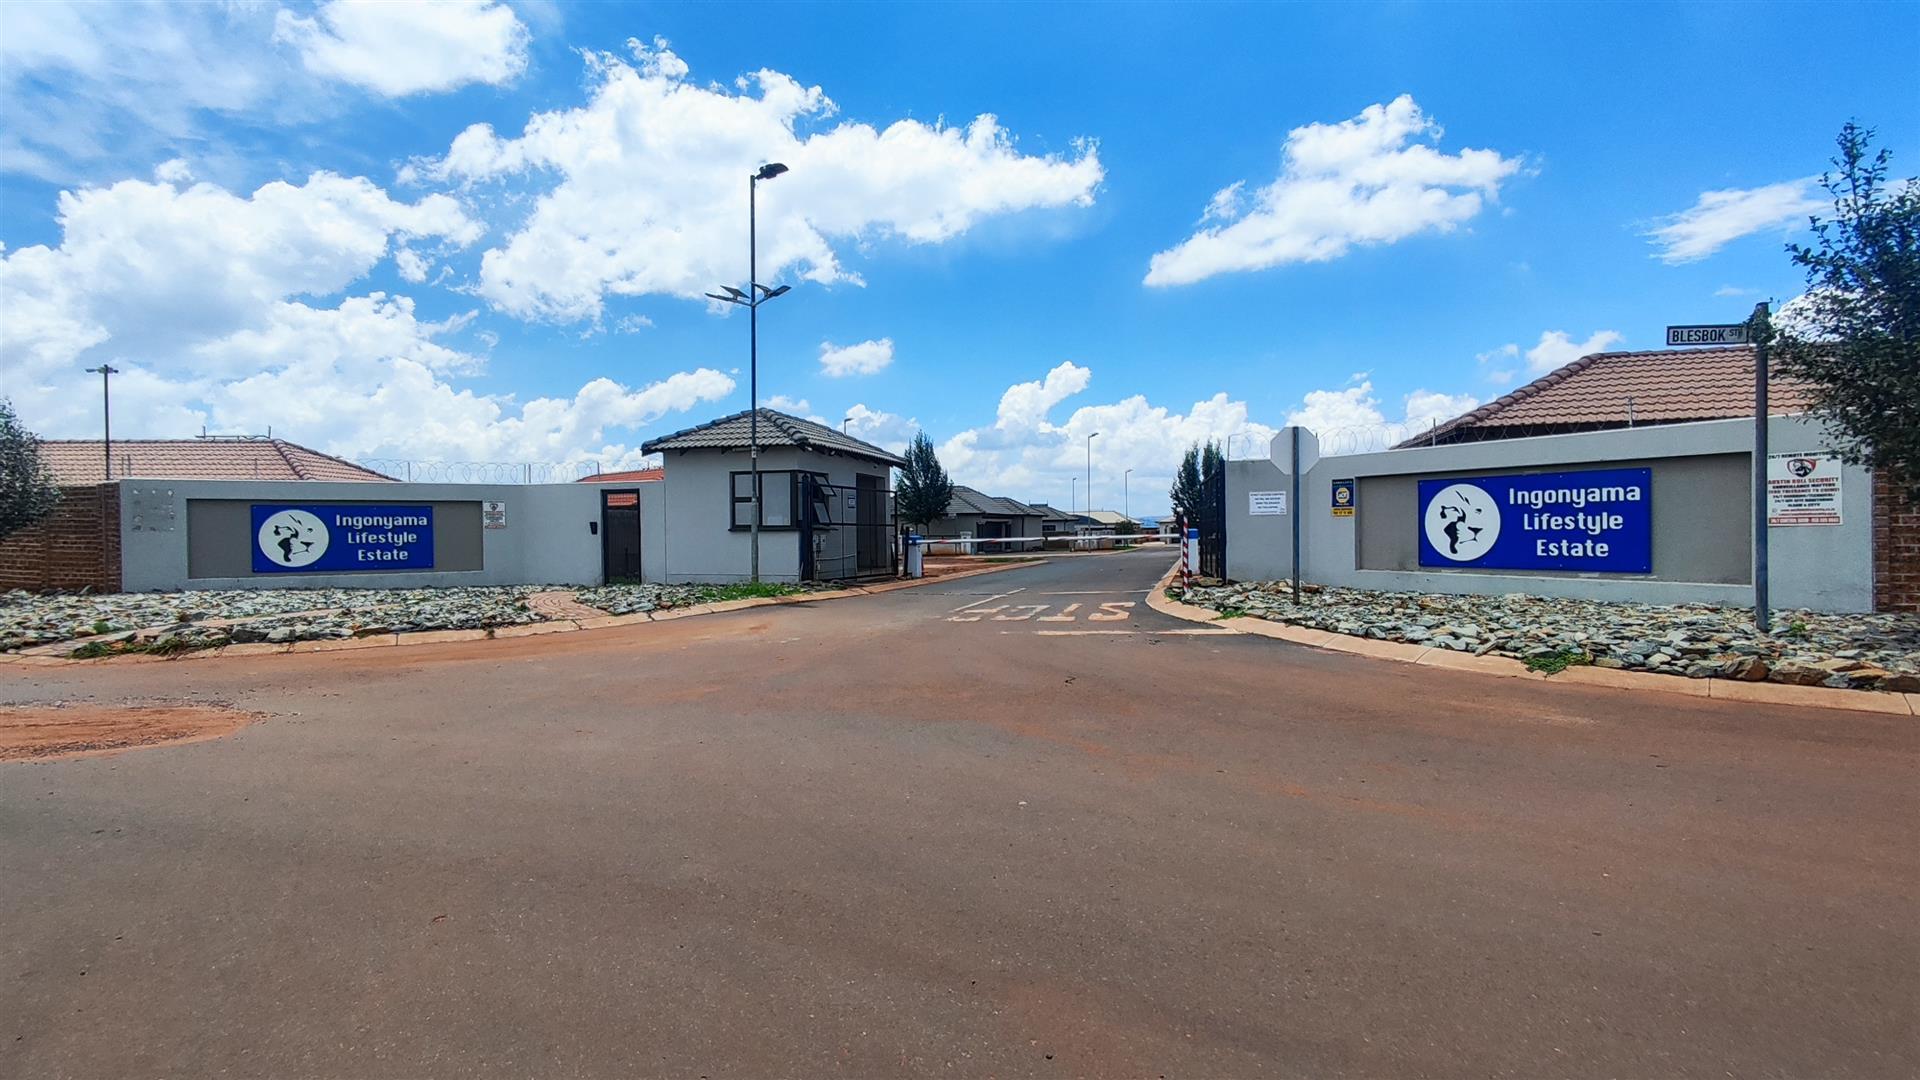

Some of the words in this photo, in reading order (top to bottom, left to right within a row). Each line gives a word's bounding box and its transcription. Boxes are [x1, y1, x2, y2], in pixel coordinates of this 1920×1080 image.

[1672, 329, 1726, 343] BLESBOK
[1509, 486, 1641, 509] Ingonyama
[336, 513, 428, 530] Ingonyama
[1523, 512, 1624, 535] Lifestyle
[347, 531, 418, 547] Lifestyle
[357, 549, 409, 561] Estate
[1536, 539, 1609, 557] Estate
